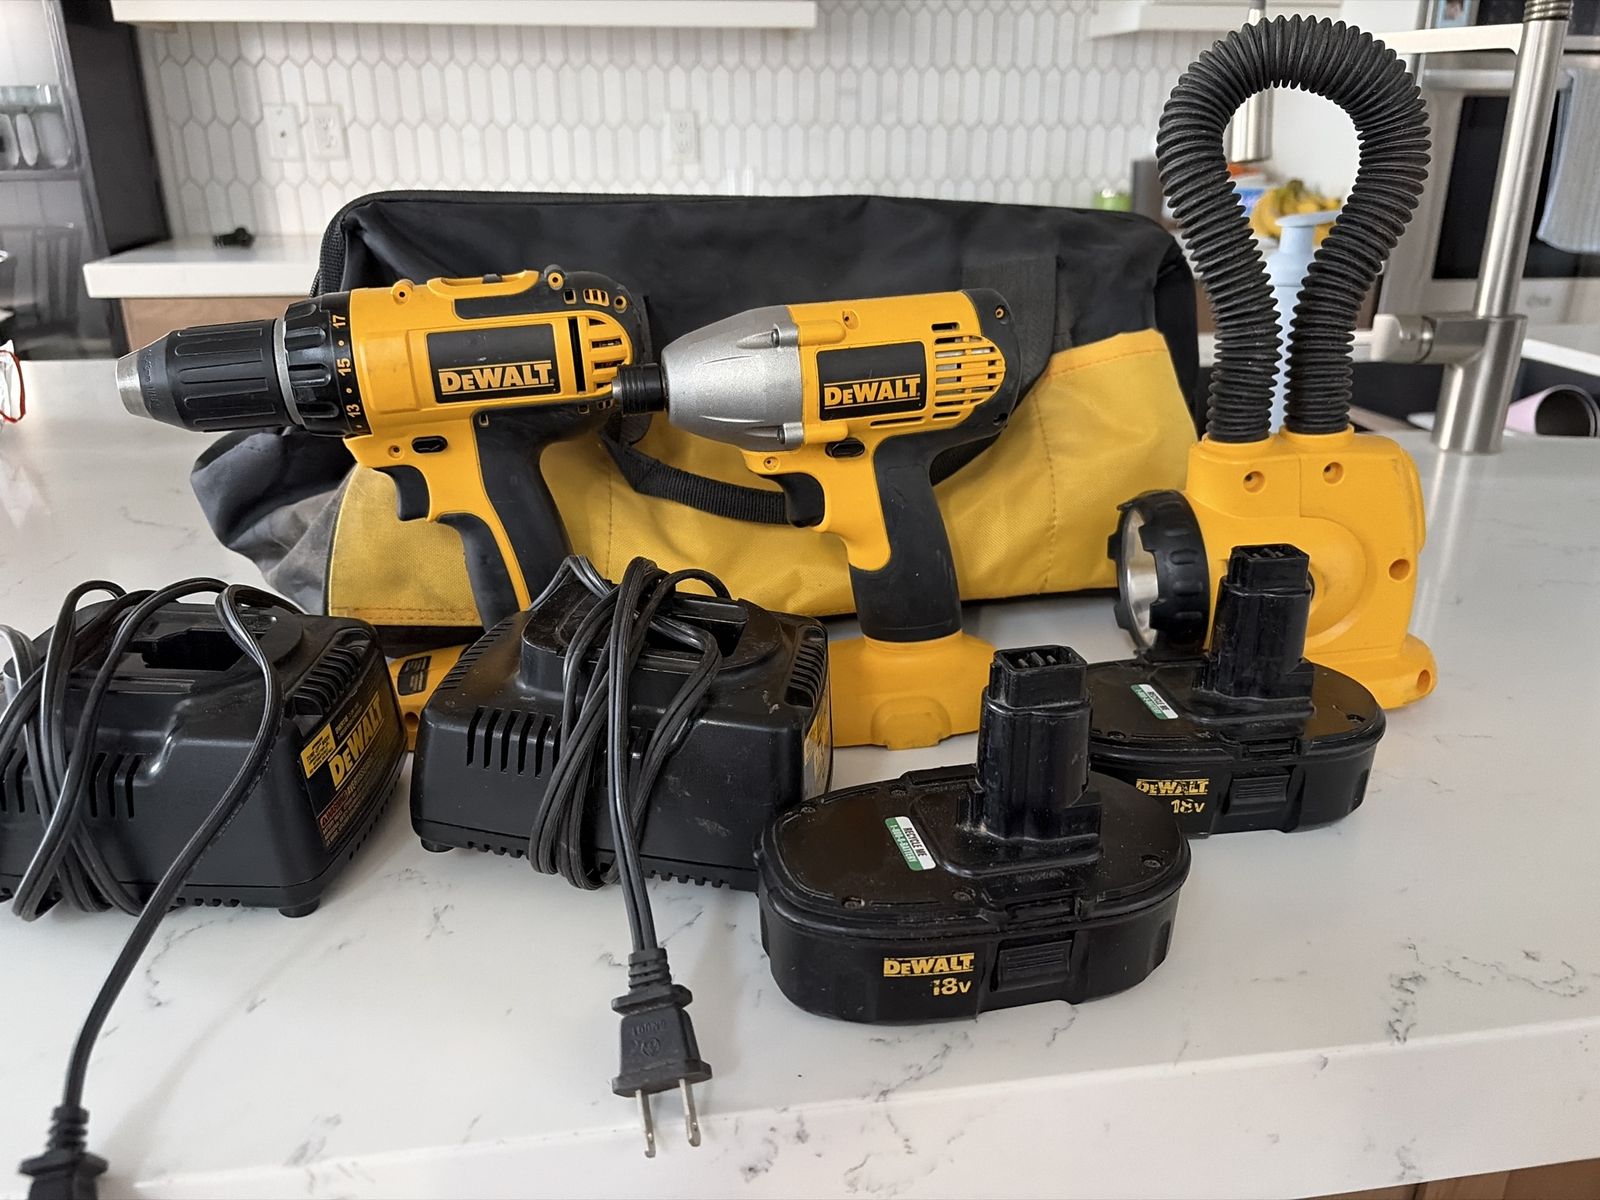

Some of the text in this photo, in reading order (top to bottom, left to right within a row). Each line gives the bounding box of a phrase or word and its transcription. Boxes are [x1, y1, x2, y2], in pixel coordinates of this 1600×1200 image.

[333, 315, 346, 328] 17
[337, 358, 351, 376] 15
[347, 404, 361, 417] 13
[903, 827, 928, 857] RECYCLE ME
